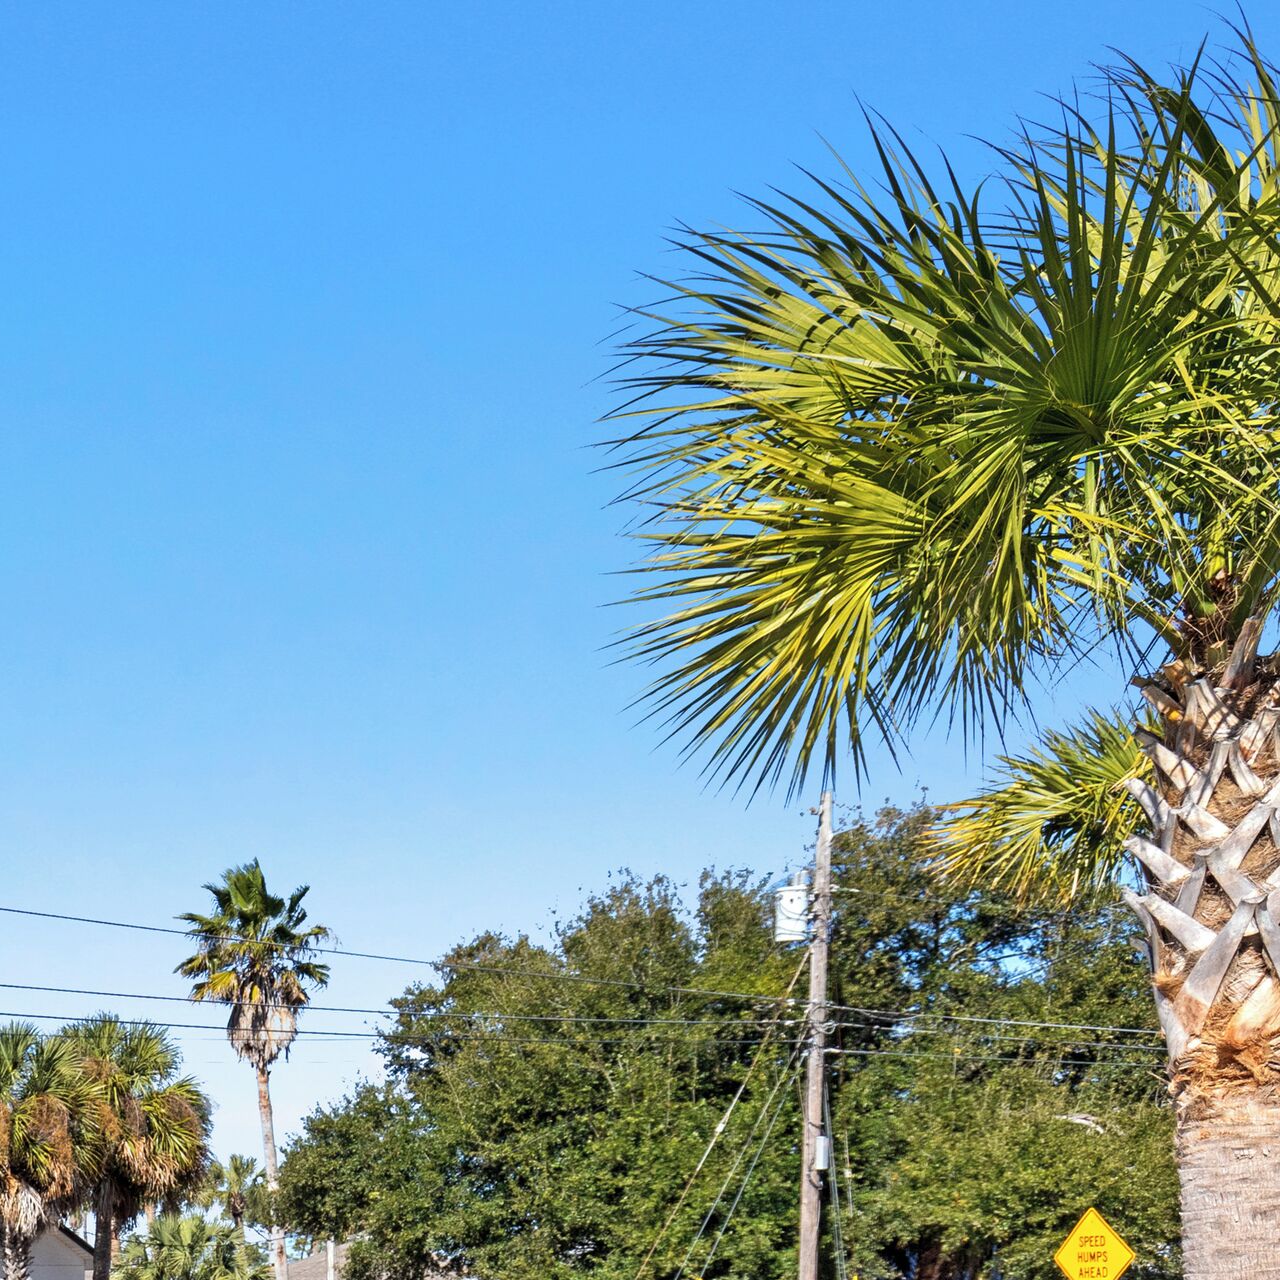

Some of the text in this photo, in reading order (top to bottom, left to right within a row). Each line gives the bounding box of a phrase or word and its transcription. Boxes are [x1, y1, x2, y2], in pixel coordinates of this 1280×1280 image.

[1078, 1235, 1106, 1248] SPEED
[1077, 1250, 1108, 1263] HUMPS
[1078, 1266, 1109, 1279] AHEAD
